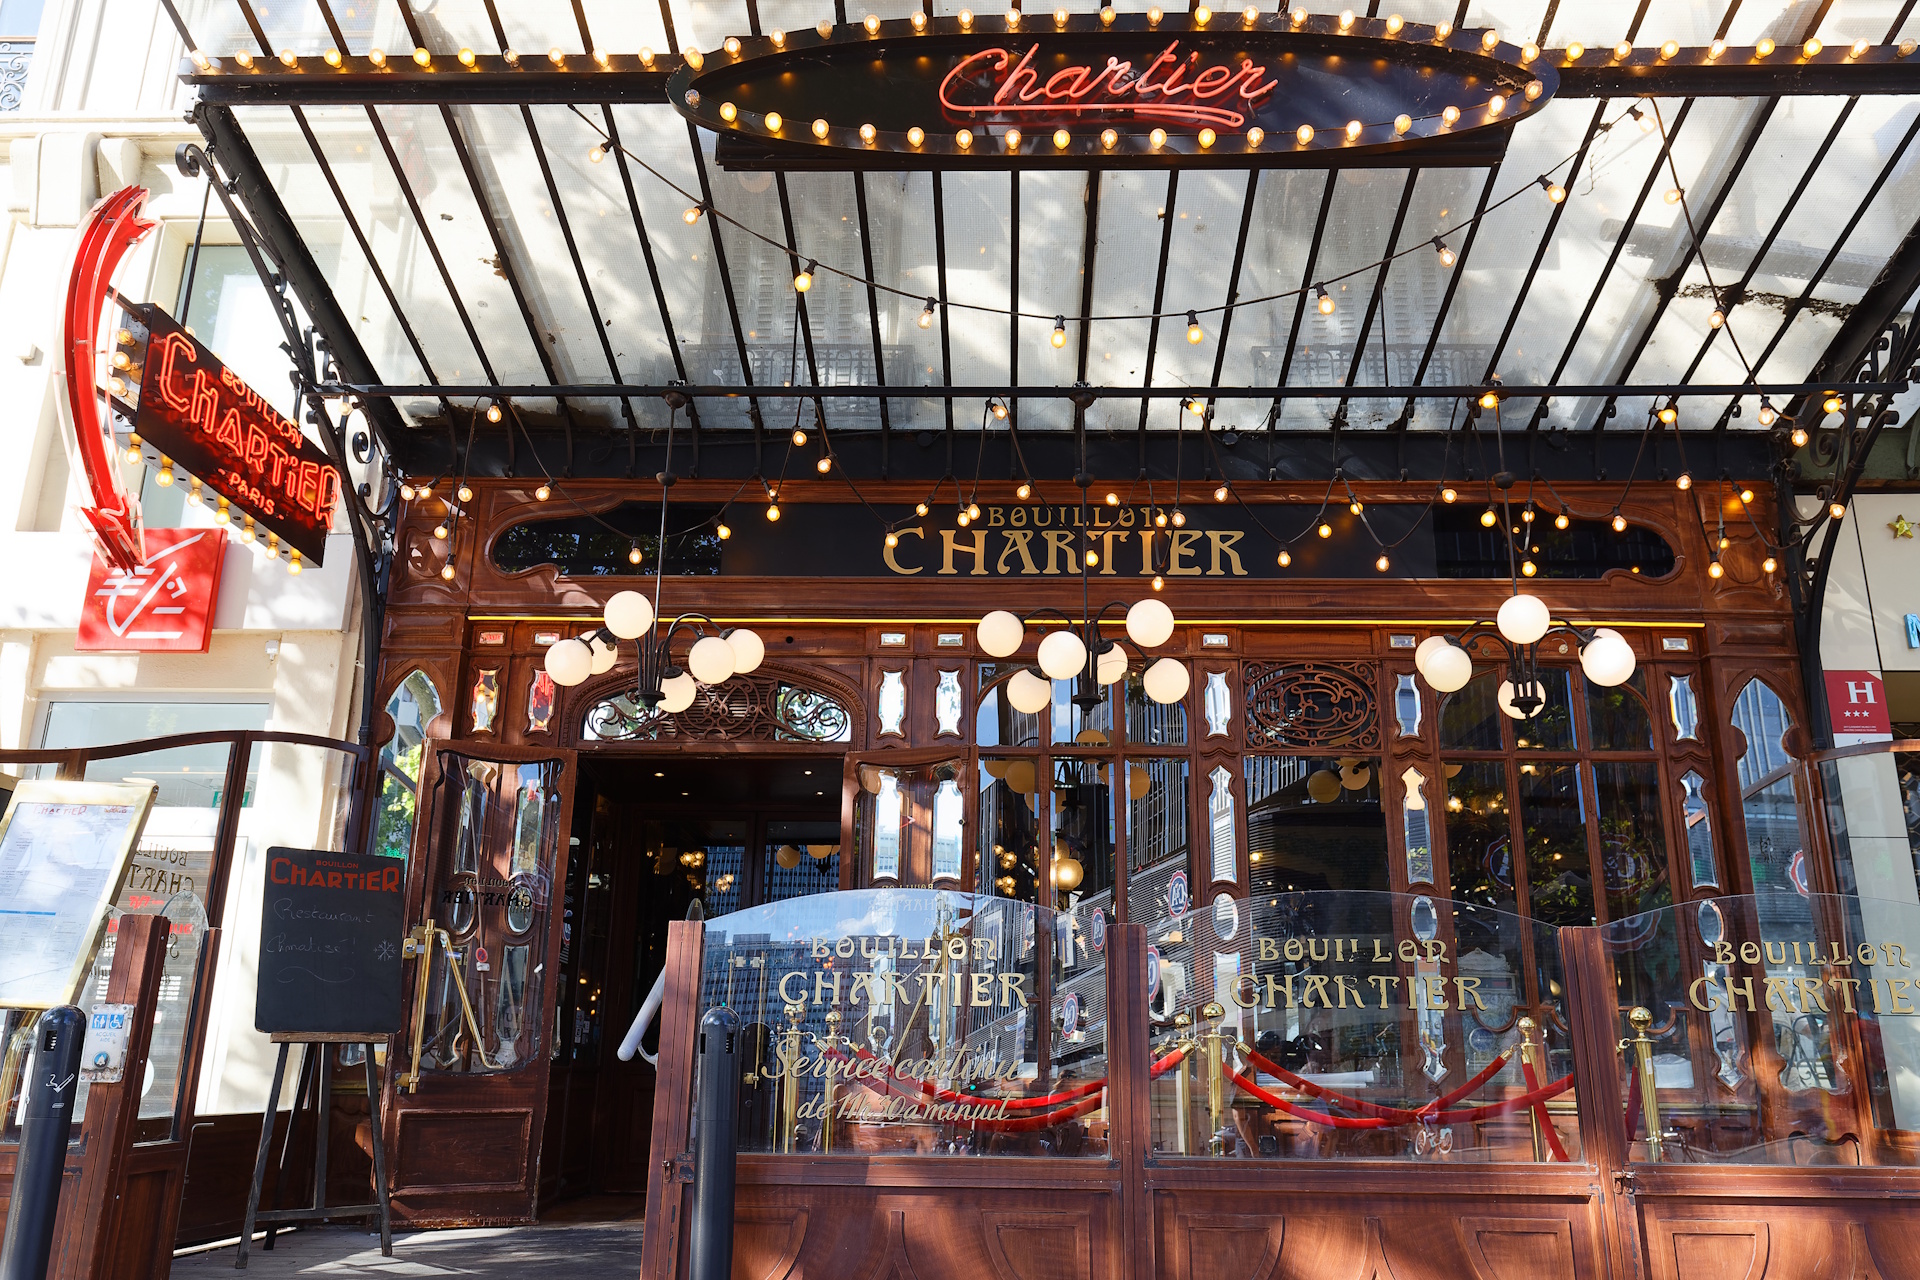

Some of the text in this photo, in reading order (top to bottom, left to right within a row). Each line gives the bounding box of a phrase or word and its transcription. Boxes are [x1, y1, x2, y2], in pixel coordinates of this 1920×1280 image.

[939, 40, 1279, 127] Chartier
[222, 366, 303, 449] BOUILLON
[229, 472, 276, 516] PARIS
[882, 526, 1249, 576] CHARTIER
[1845, 681, 1878, 704] H
[315, 860, 359, 869] BOUILLON
[273, 897, 375, 923] Restaurant
[810, 935, 998, 962] BOUILLON
[1712, 940, 1912, 969] BOUILLON
[778, 971, 1030, 1009] CHARTIER
[1230, 974, 1490, 1012] CHARTIER
[1688, 975, 1920, 1015] CHARTIE
[761, 1038, 890, 1080] Service
[893, 1042, 1028, 1082] continu
[796, 1092, 835, 1121] de
[922, 1089, 1013, 1122] minuit
